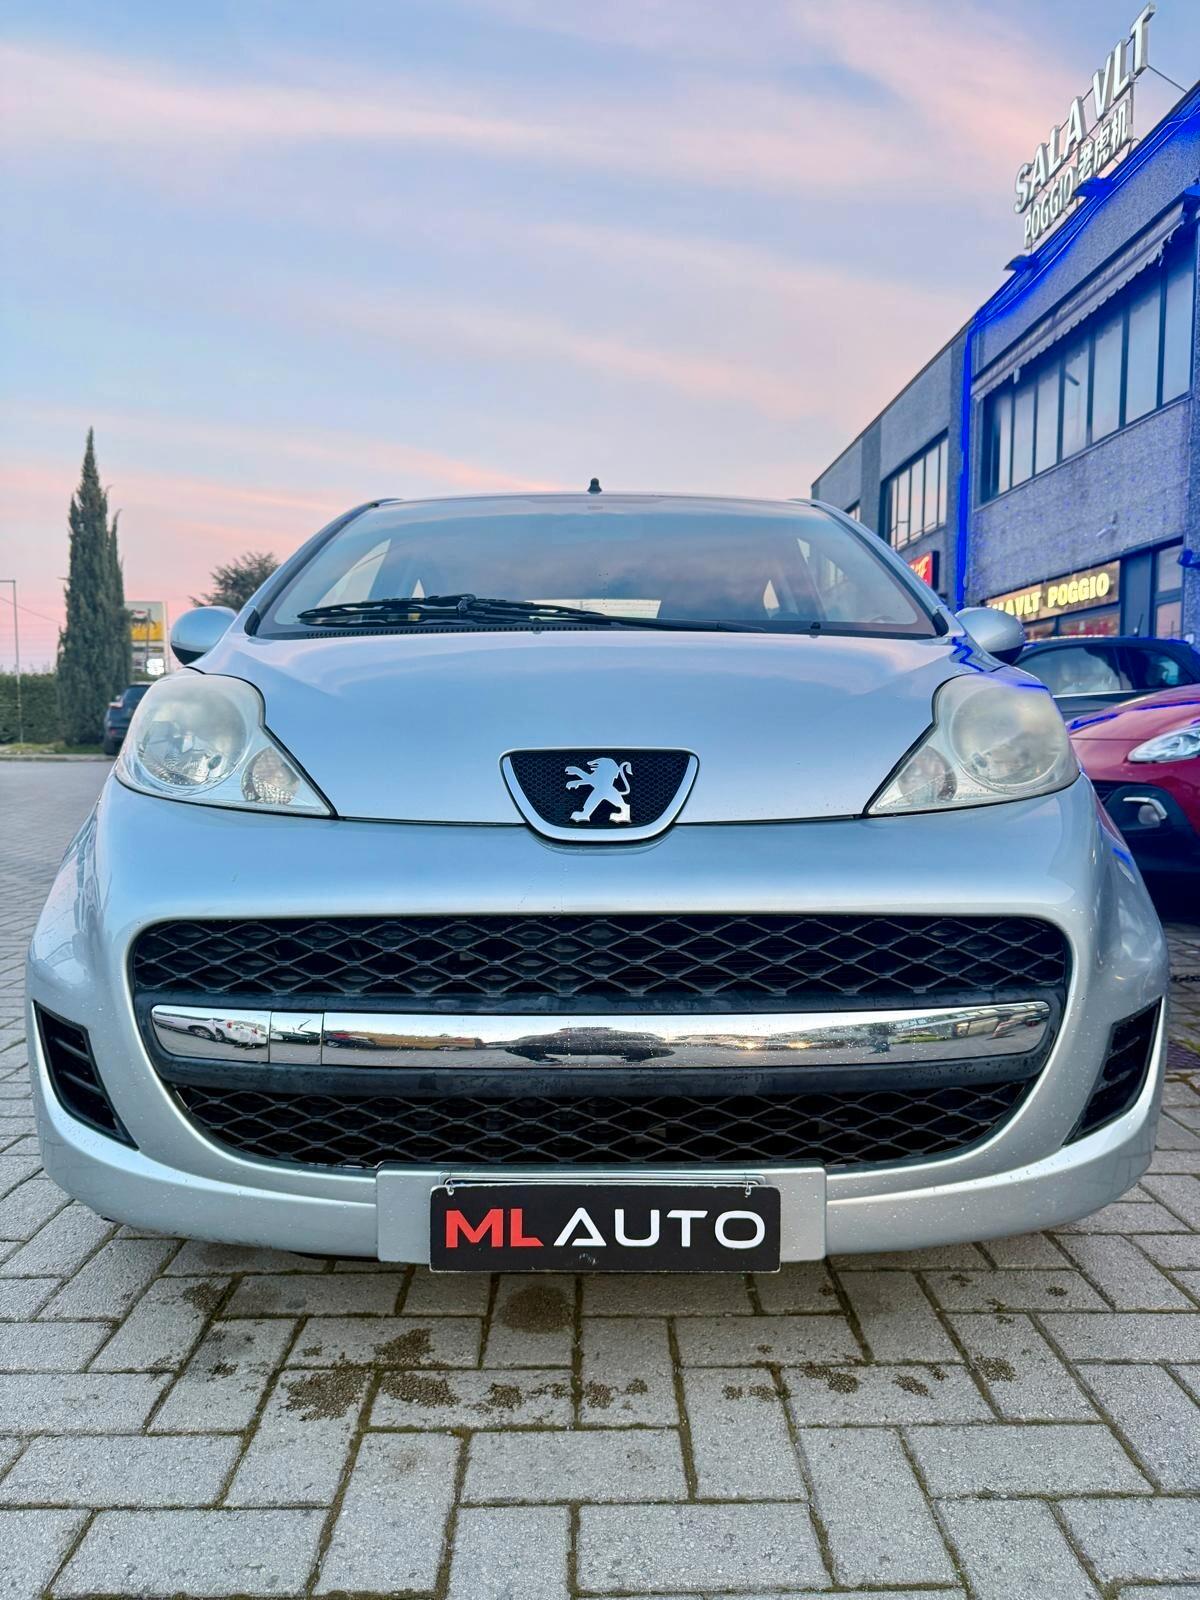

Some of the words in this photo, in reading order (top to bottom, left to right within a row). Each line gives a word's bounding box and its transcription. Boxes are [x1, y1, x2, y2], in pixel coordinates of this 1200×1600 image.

[1014, 96, 1086, 213] SALA
[1092, 2, 1156, 121] VLT
[1023, 166, 1077, 249] POGGIO
[1078, 98, 1131, 182] 老虎机
[1047, 572, 1110, 608] POGGIO
[445, 1208, 544, 1248] ML
[553, 1207, 767, 1249] AUTO
